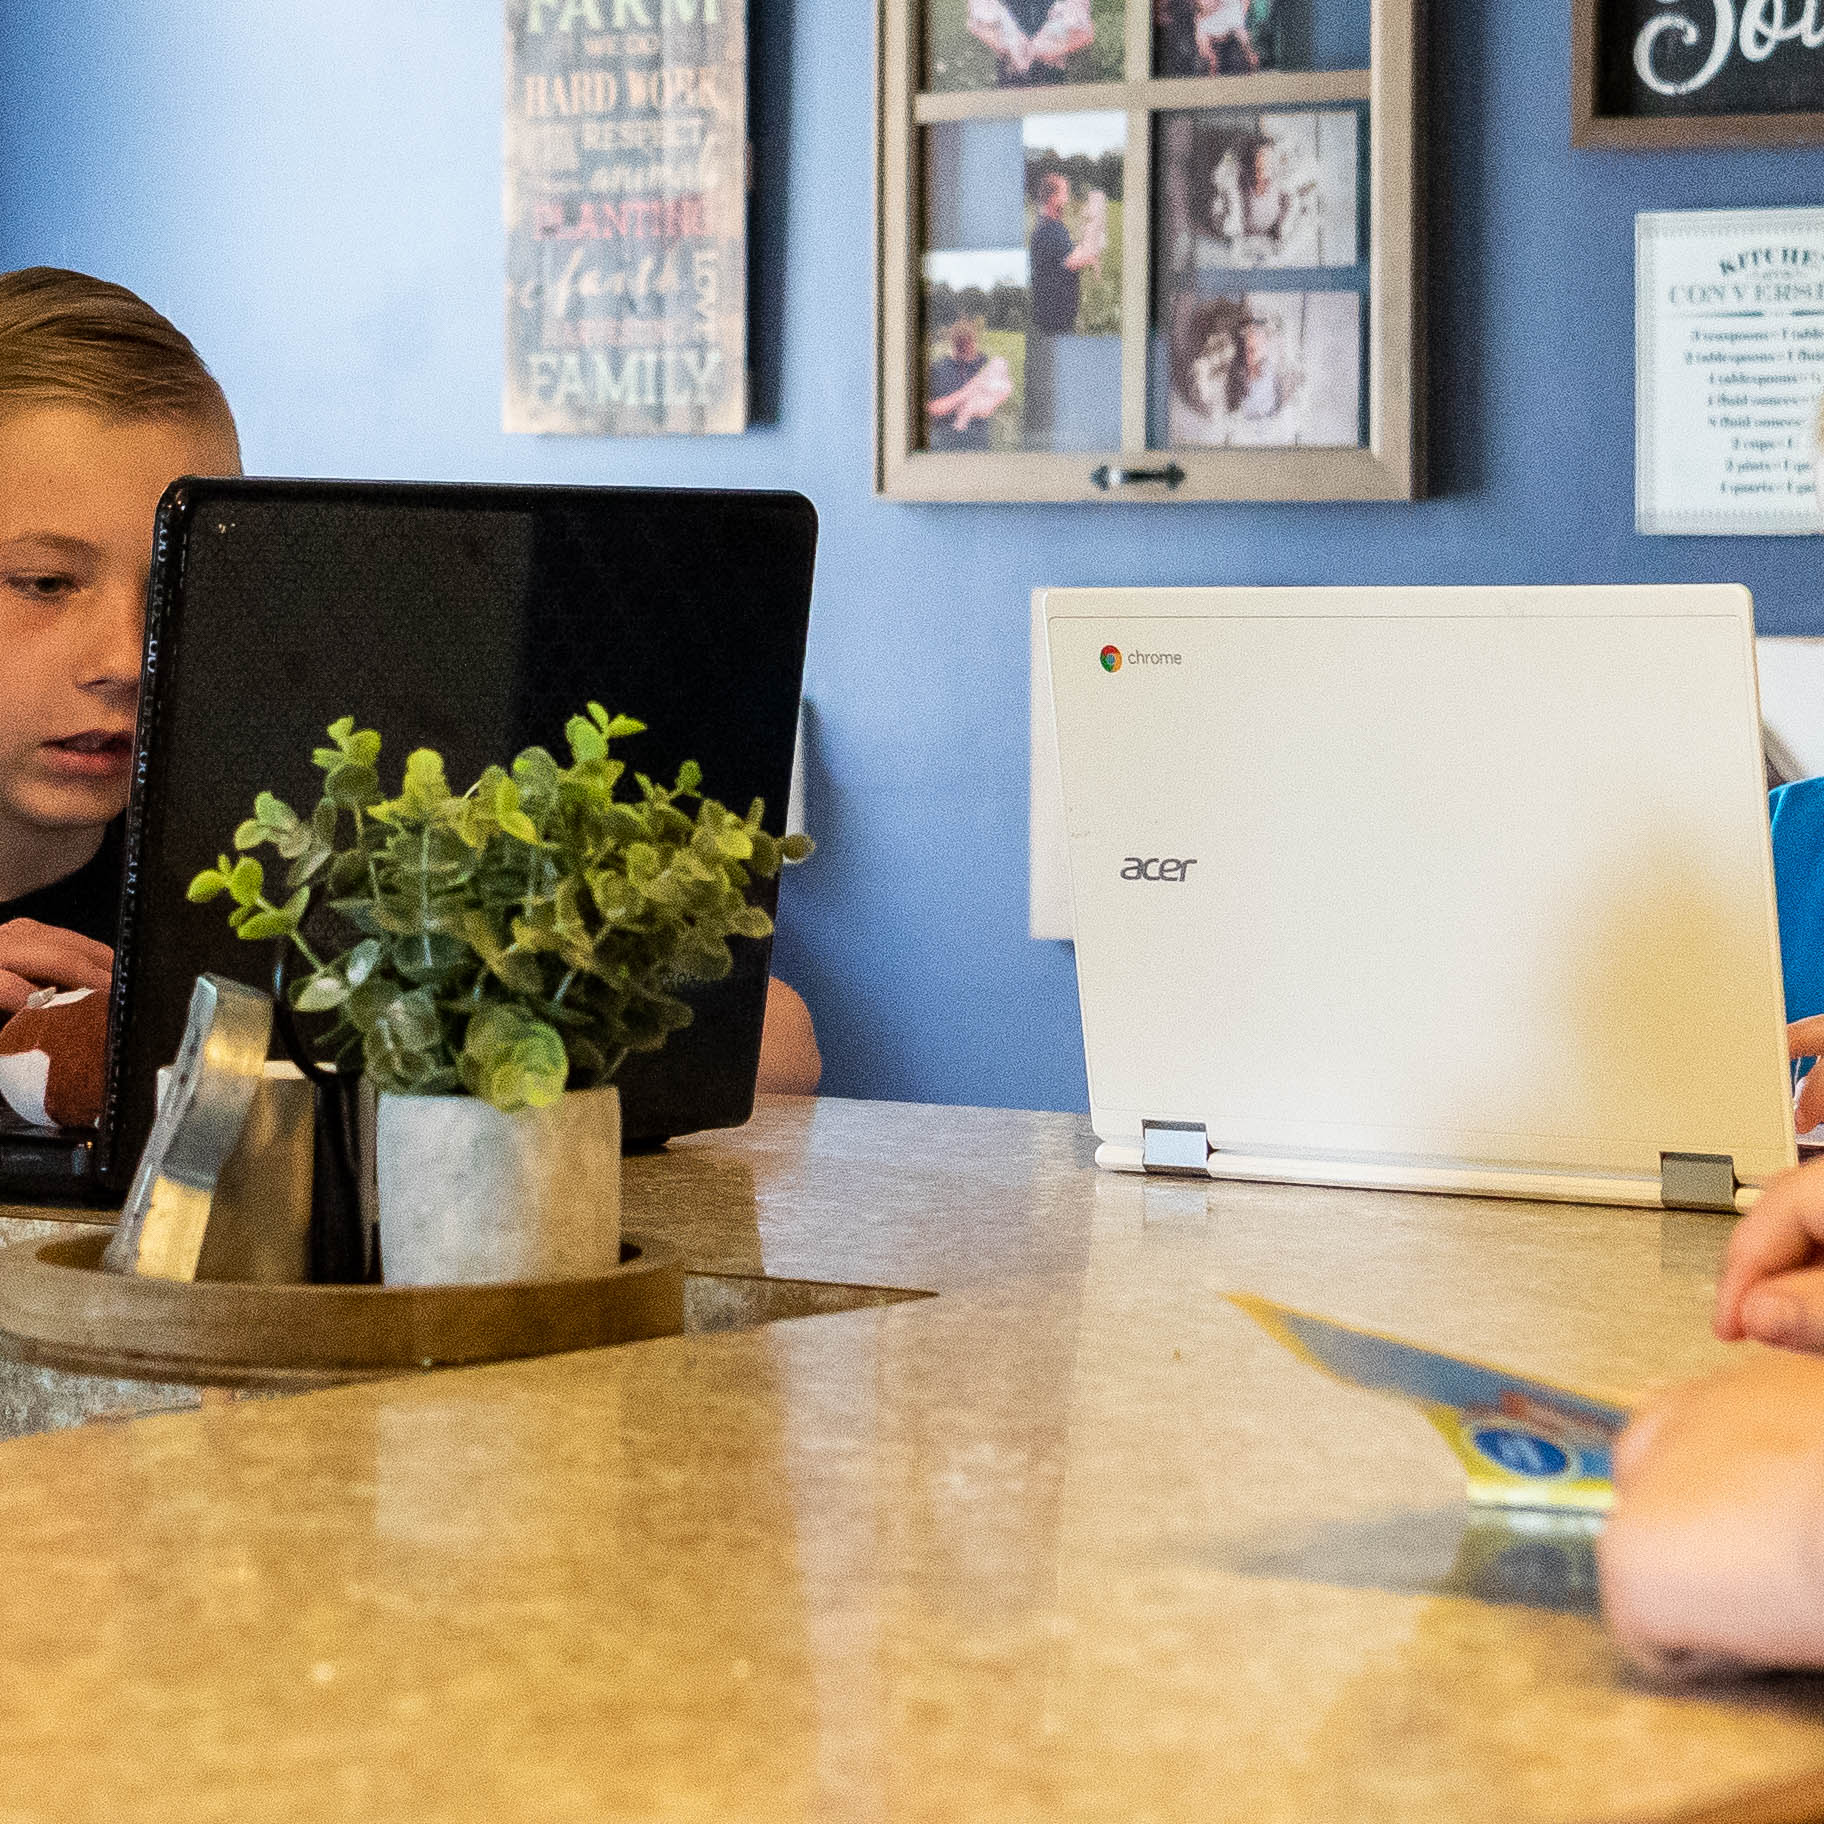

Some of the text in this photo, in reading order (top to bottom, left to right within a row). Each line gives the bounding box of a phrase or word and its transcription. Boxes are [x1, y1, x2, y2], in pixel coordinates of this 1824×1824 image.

[526, 348, 722, 407] FAMILY
[1127, 650, 1182, 666] chrome
[1120, 857, 1198, 882] acer
